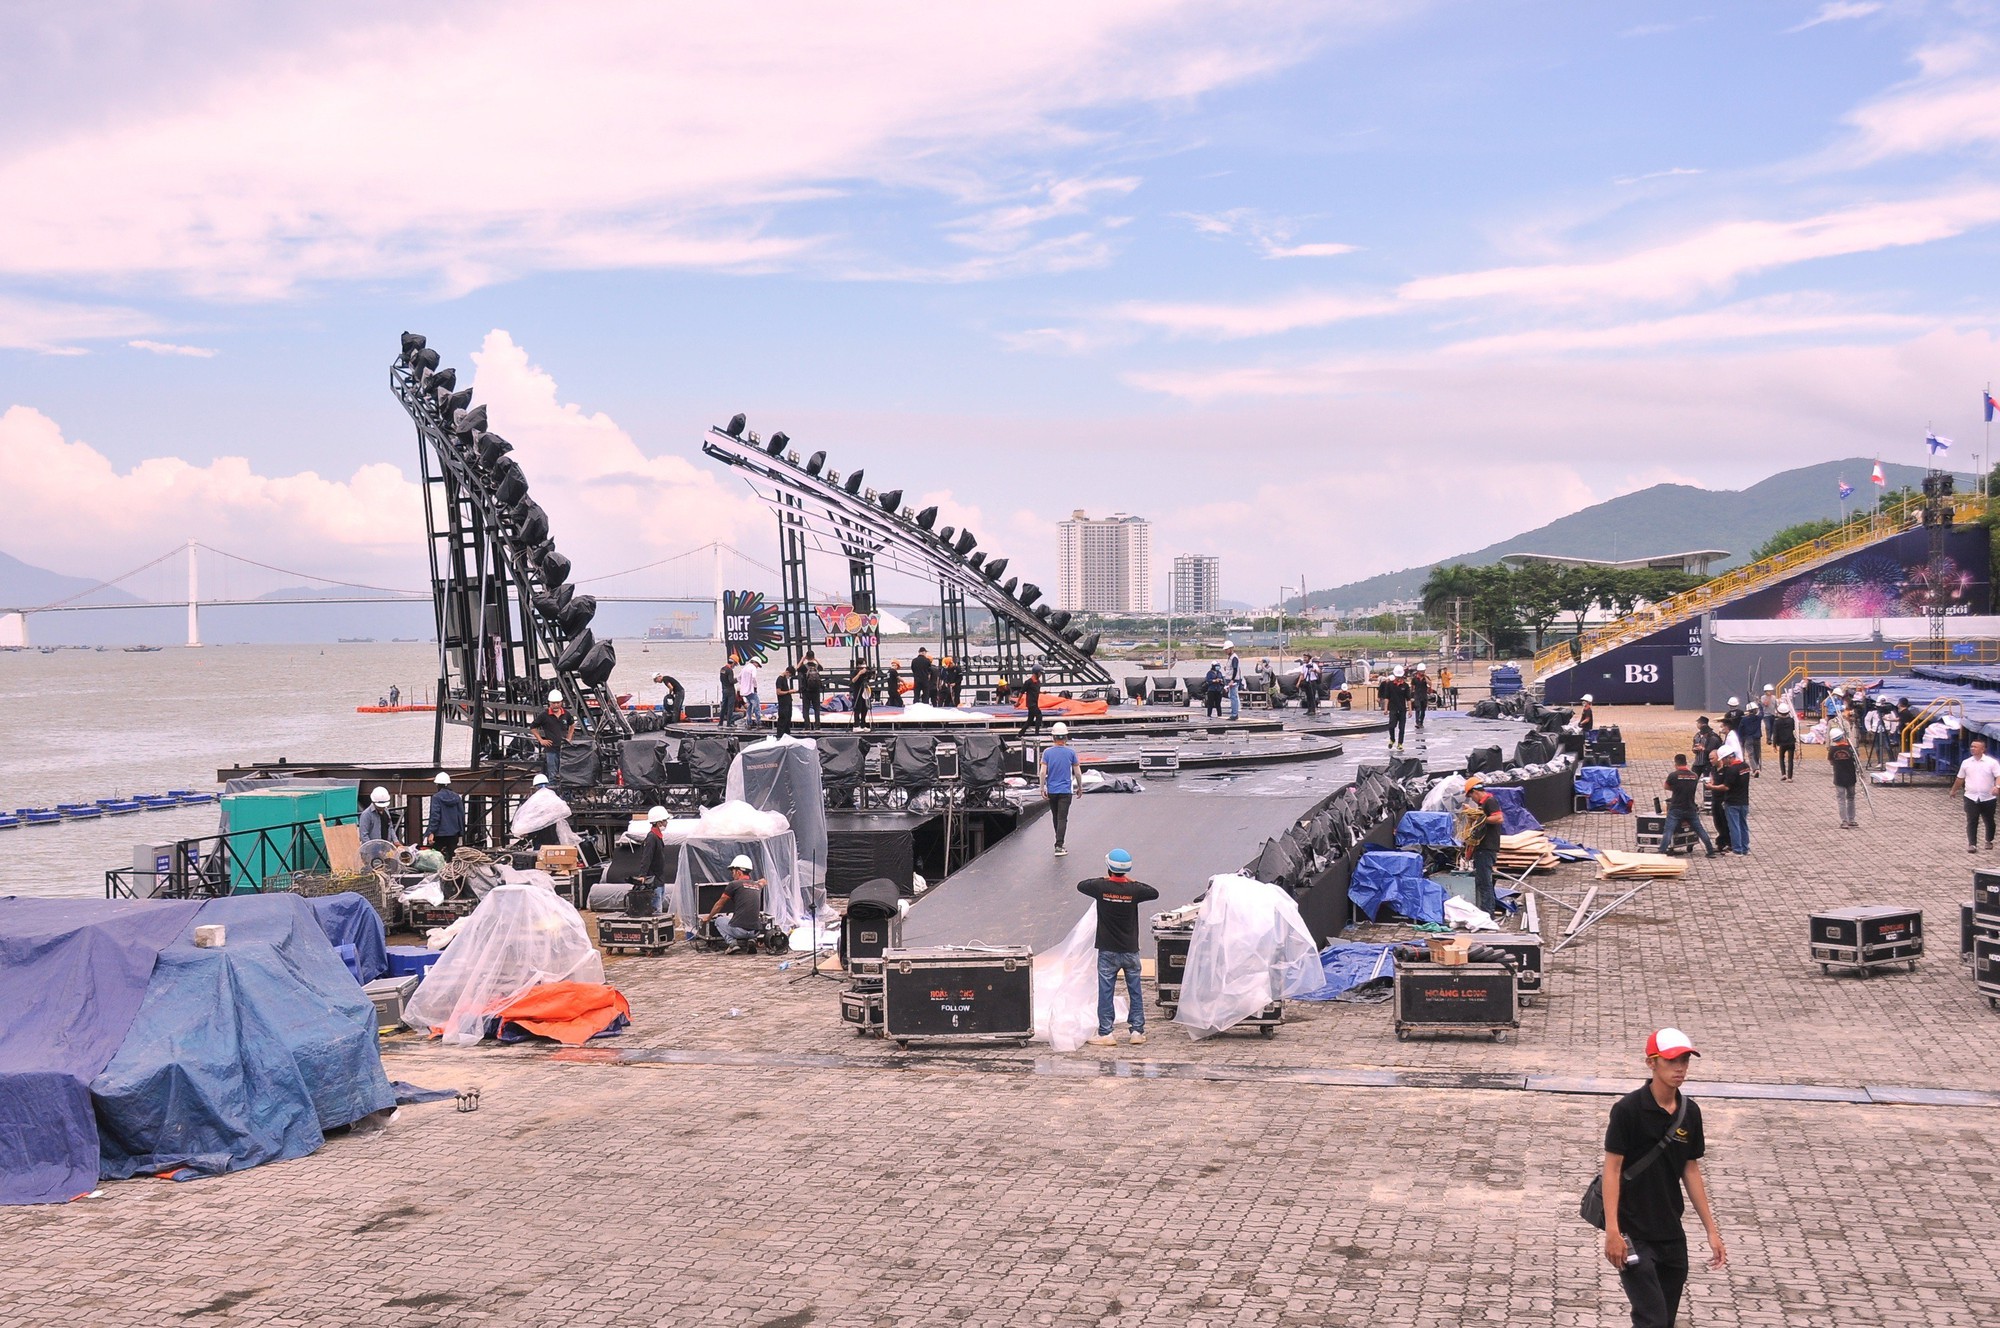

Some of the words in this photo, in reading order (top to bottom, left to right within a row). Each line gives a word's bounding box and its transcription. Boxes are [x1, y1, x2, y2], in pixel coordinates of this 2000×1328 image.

[726, 615, 751, 632] DIFF
[815, 605, 882, 634] WOW
[727, 632, 750, 641] 2023
[825, 636, 842, 648] DA
[845, 636, 878, 647] NANG
[1624, 663, 1659, 684] B3
[941, 1004, 971, 1012] FOLLOW
